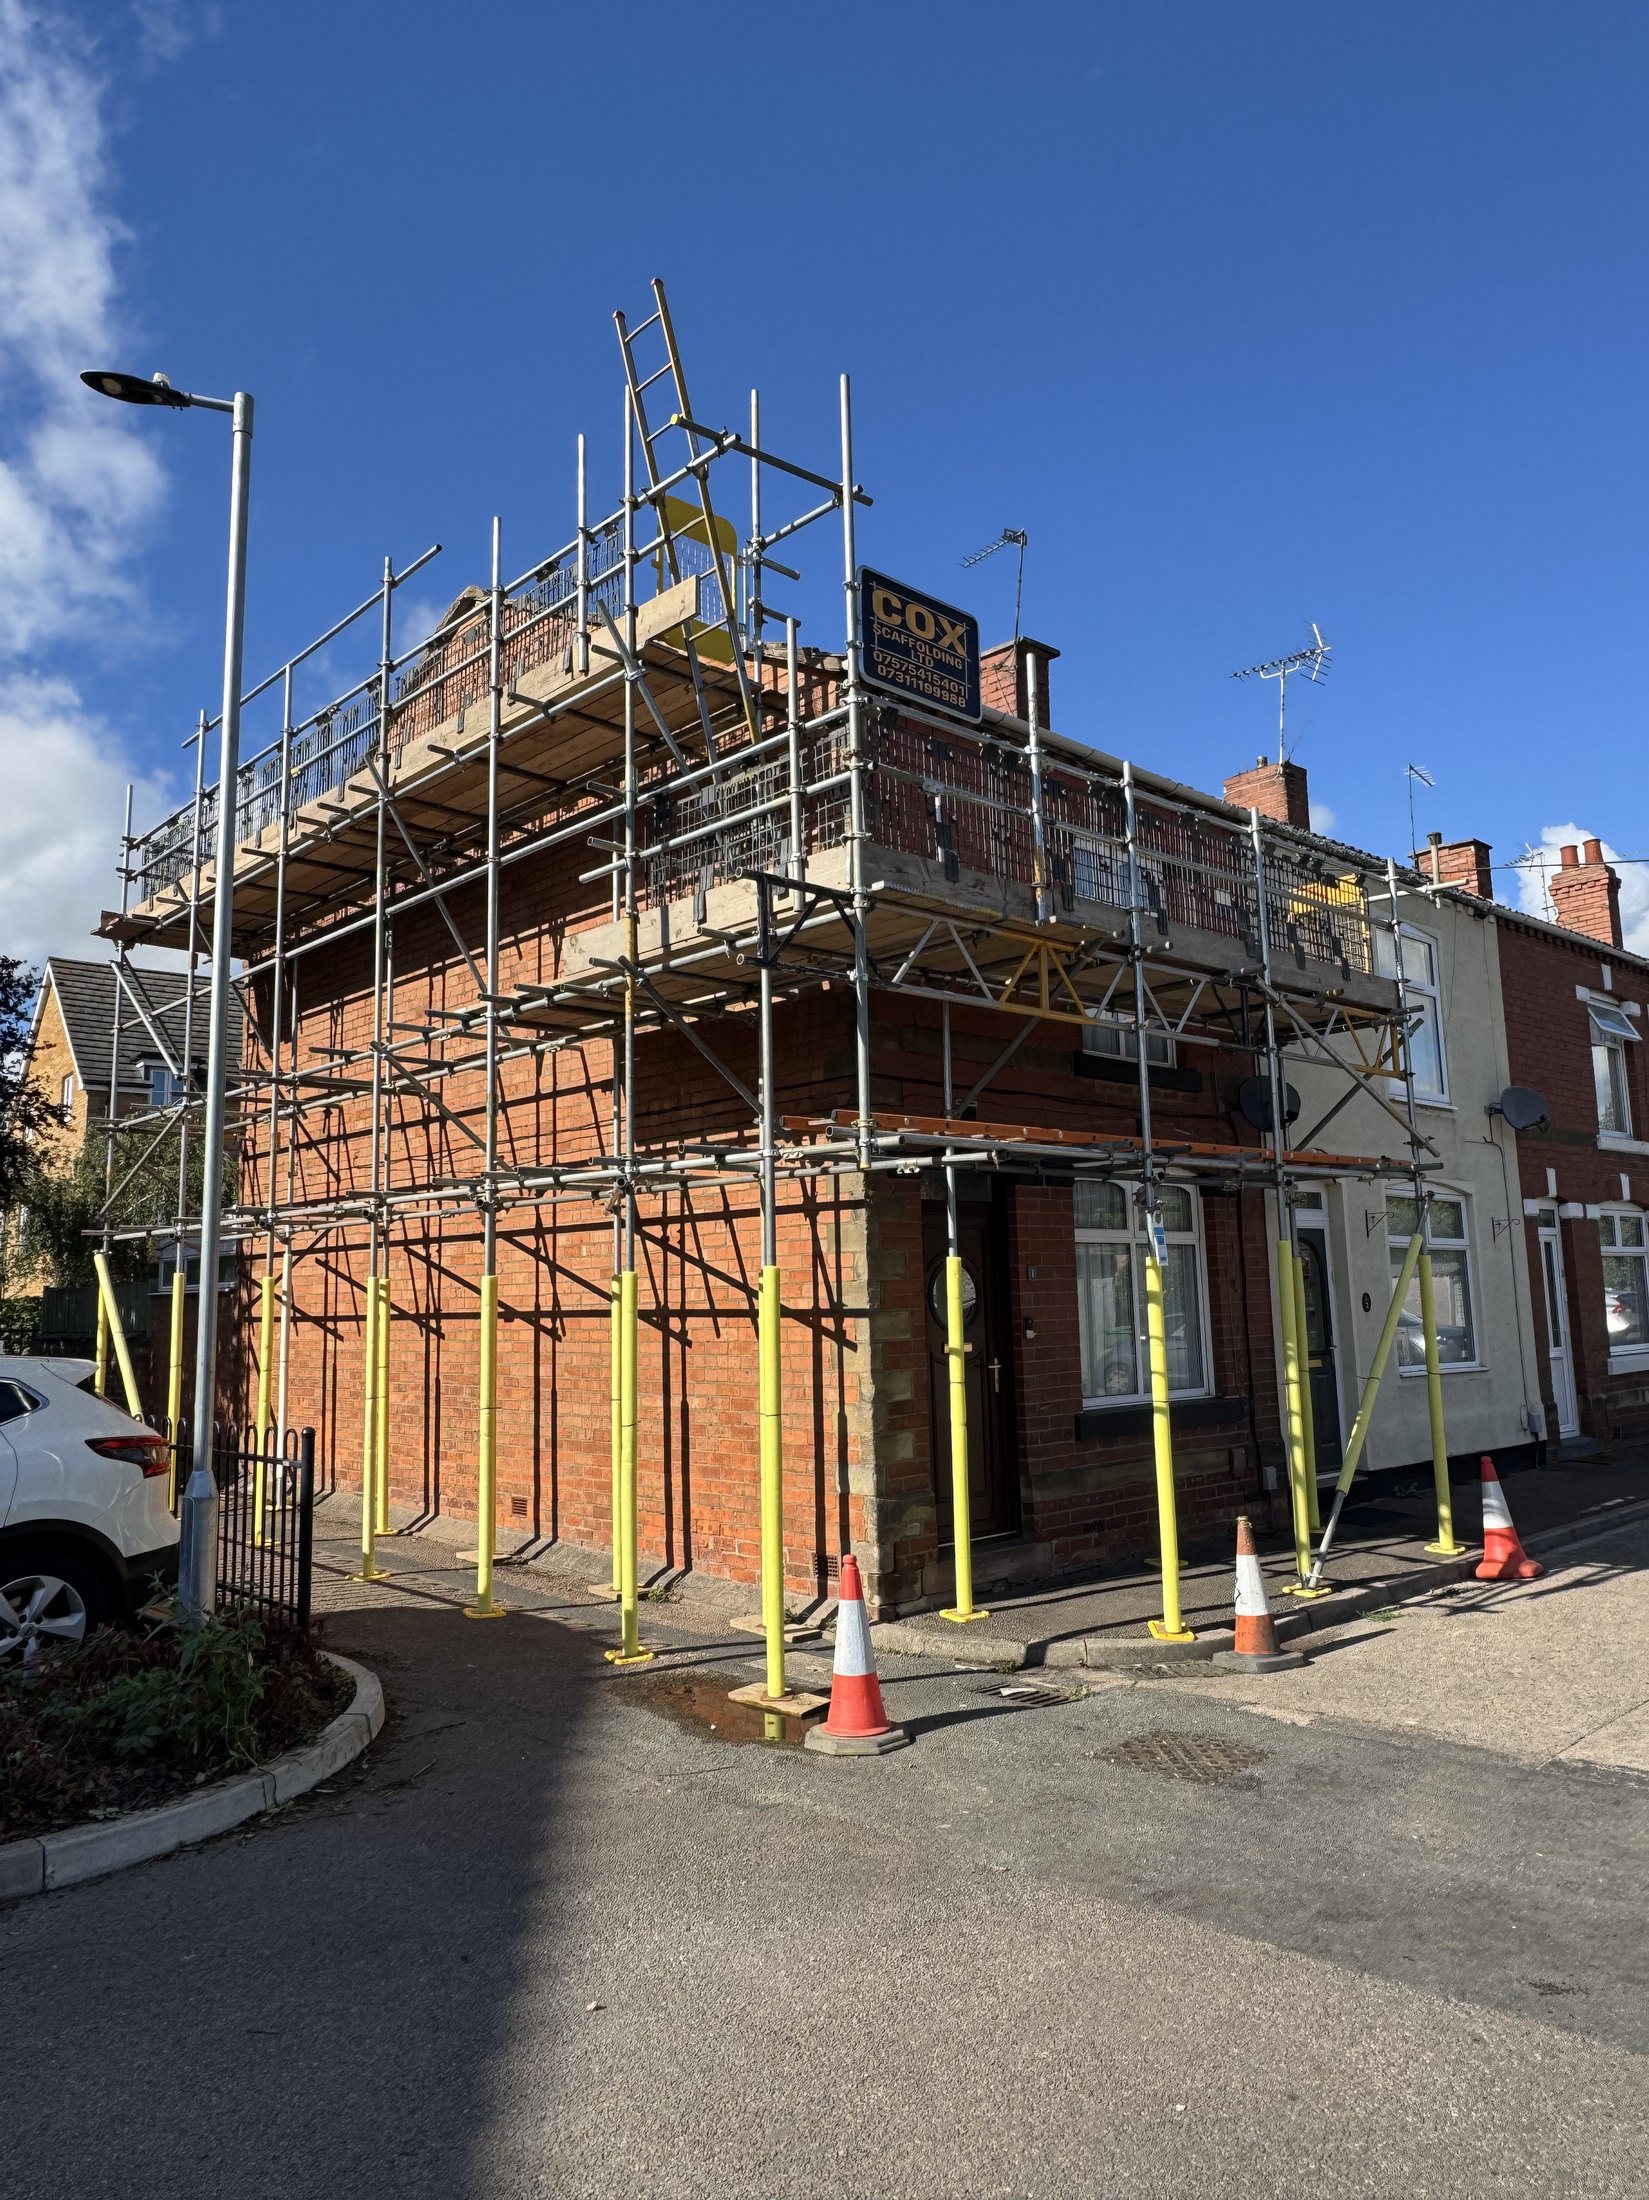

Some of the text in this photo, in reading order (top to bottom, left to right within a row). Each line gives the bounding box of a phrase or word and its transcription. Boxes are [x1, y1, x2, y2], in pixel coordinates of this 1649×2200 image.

[872, 589, 966, 656] COX
[873, 623, 962, 670] SCAFFOLDING
[911, 649, 934, 667] LTD
[873, 650, 965, 696] 07575415401
